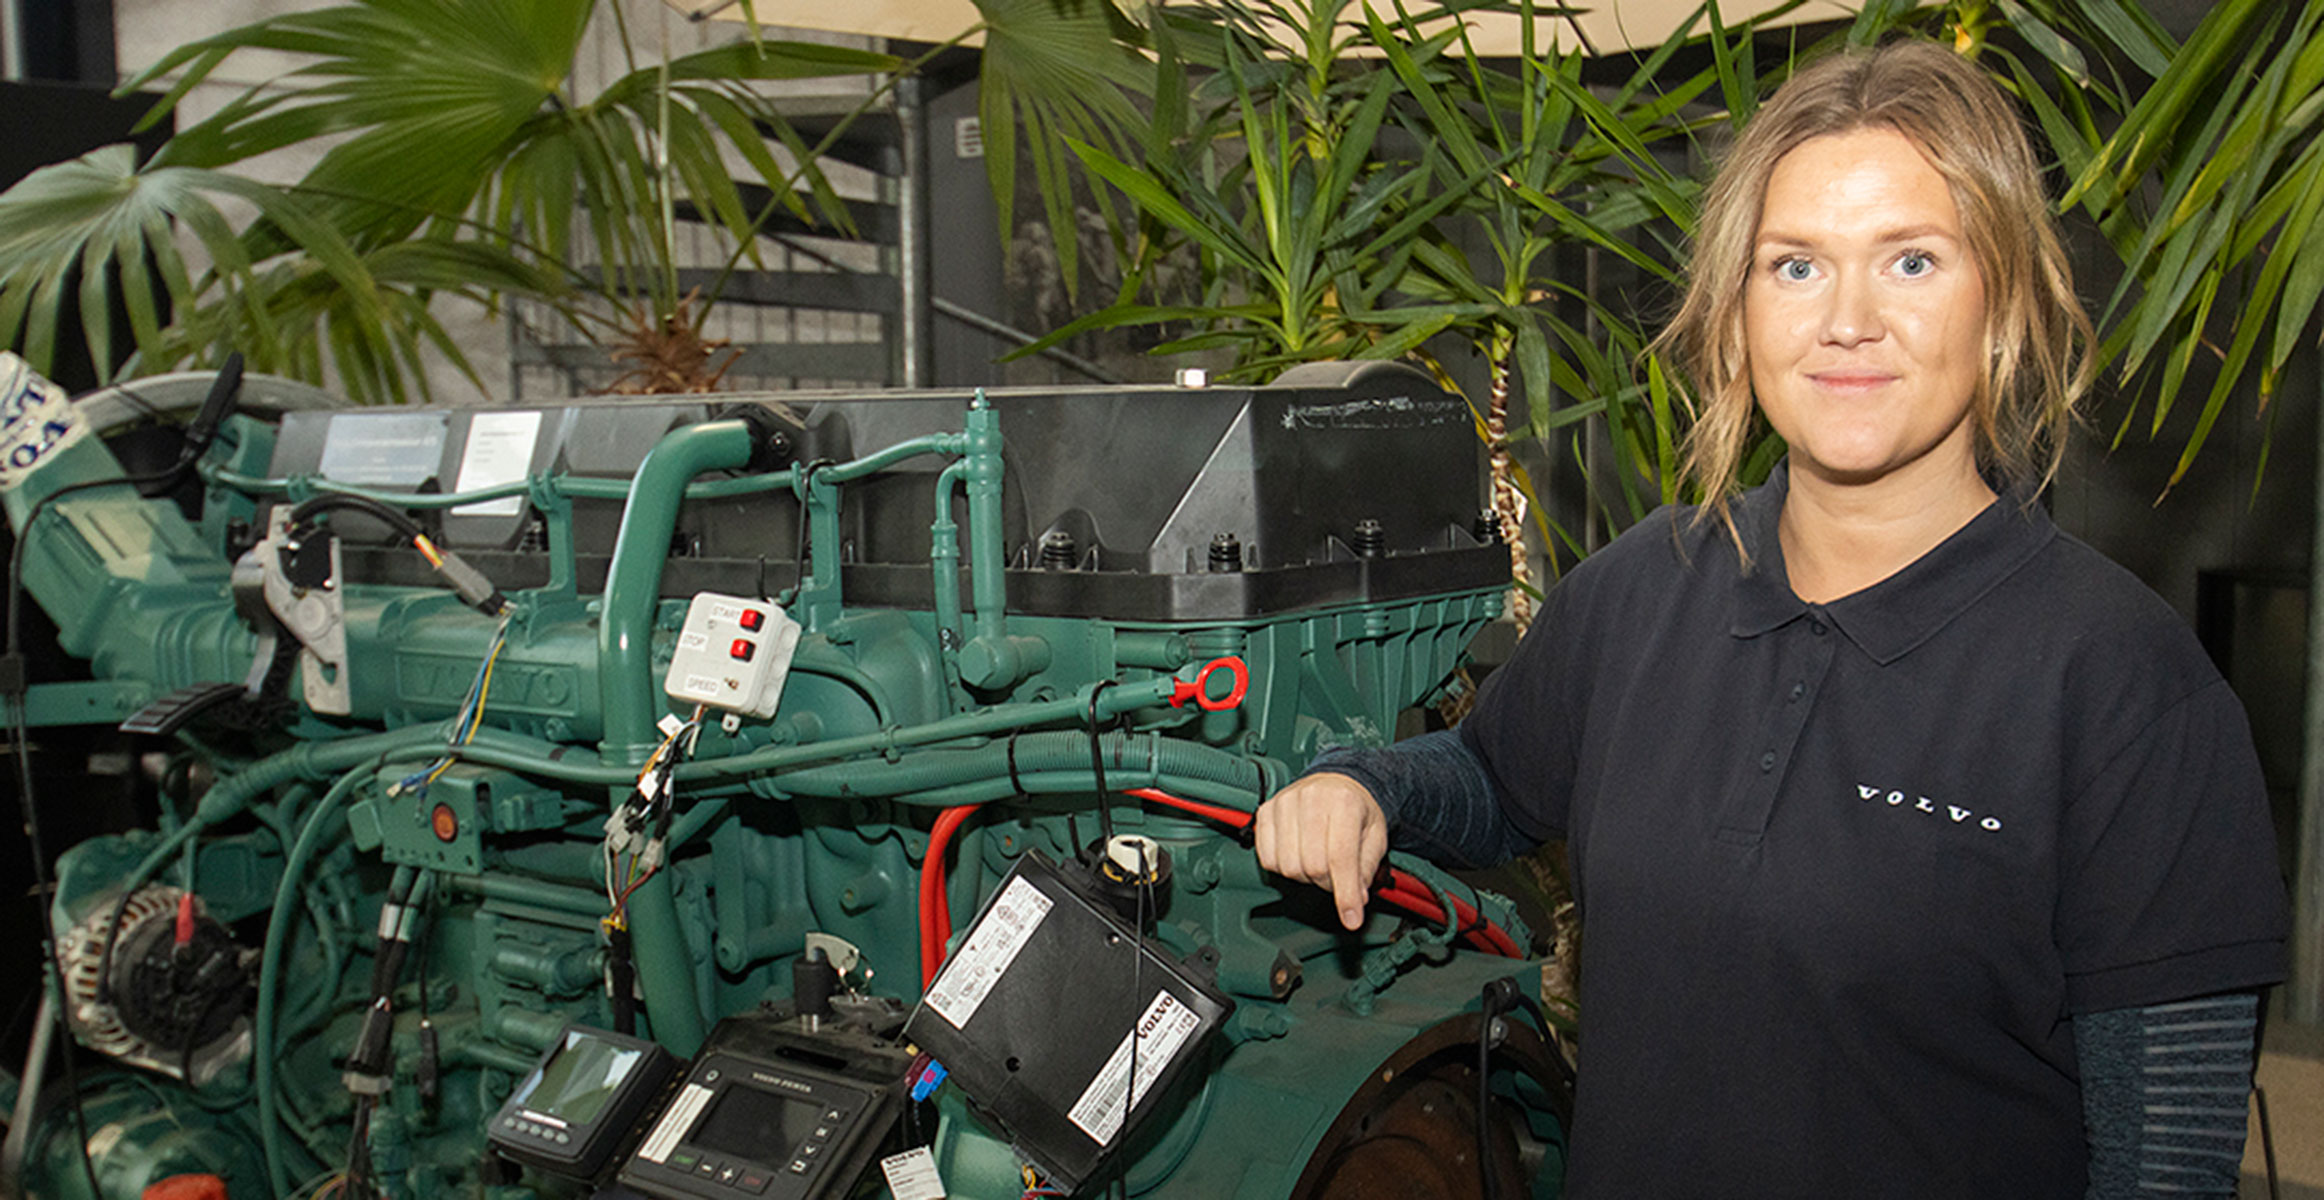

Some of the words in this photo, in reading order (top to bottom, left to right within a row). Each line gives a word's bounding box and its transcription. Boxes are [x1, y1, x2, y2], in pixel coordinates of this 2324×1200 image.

[712, 605, 740, 619] START
[403, 661, 570, 707] VOVO
[687, 677, 718, 692] SPEED
[1856, 783, 2002, 832] VOLVO
[1136, 995, 1175, 1041] VOLVO
